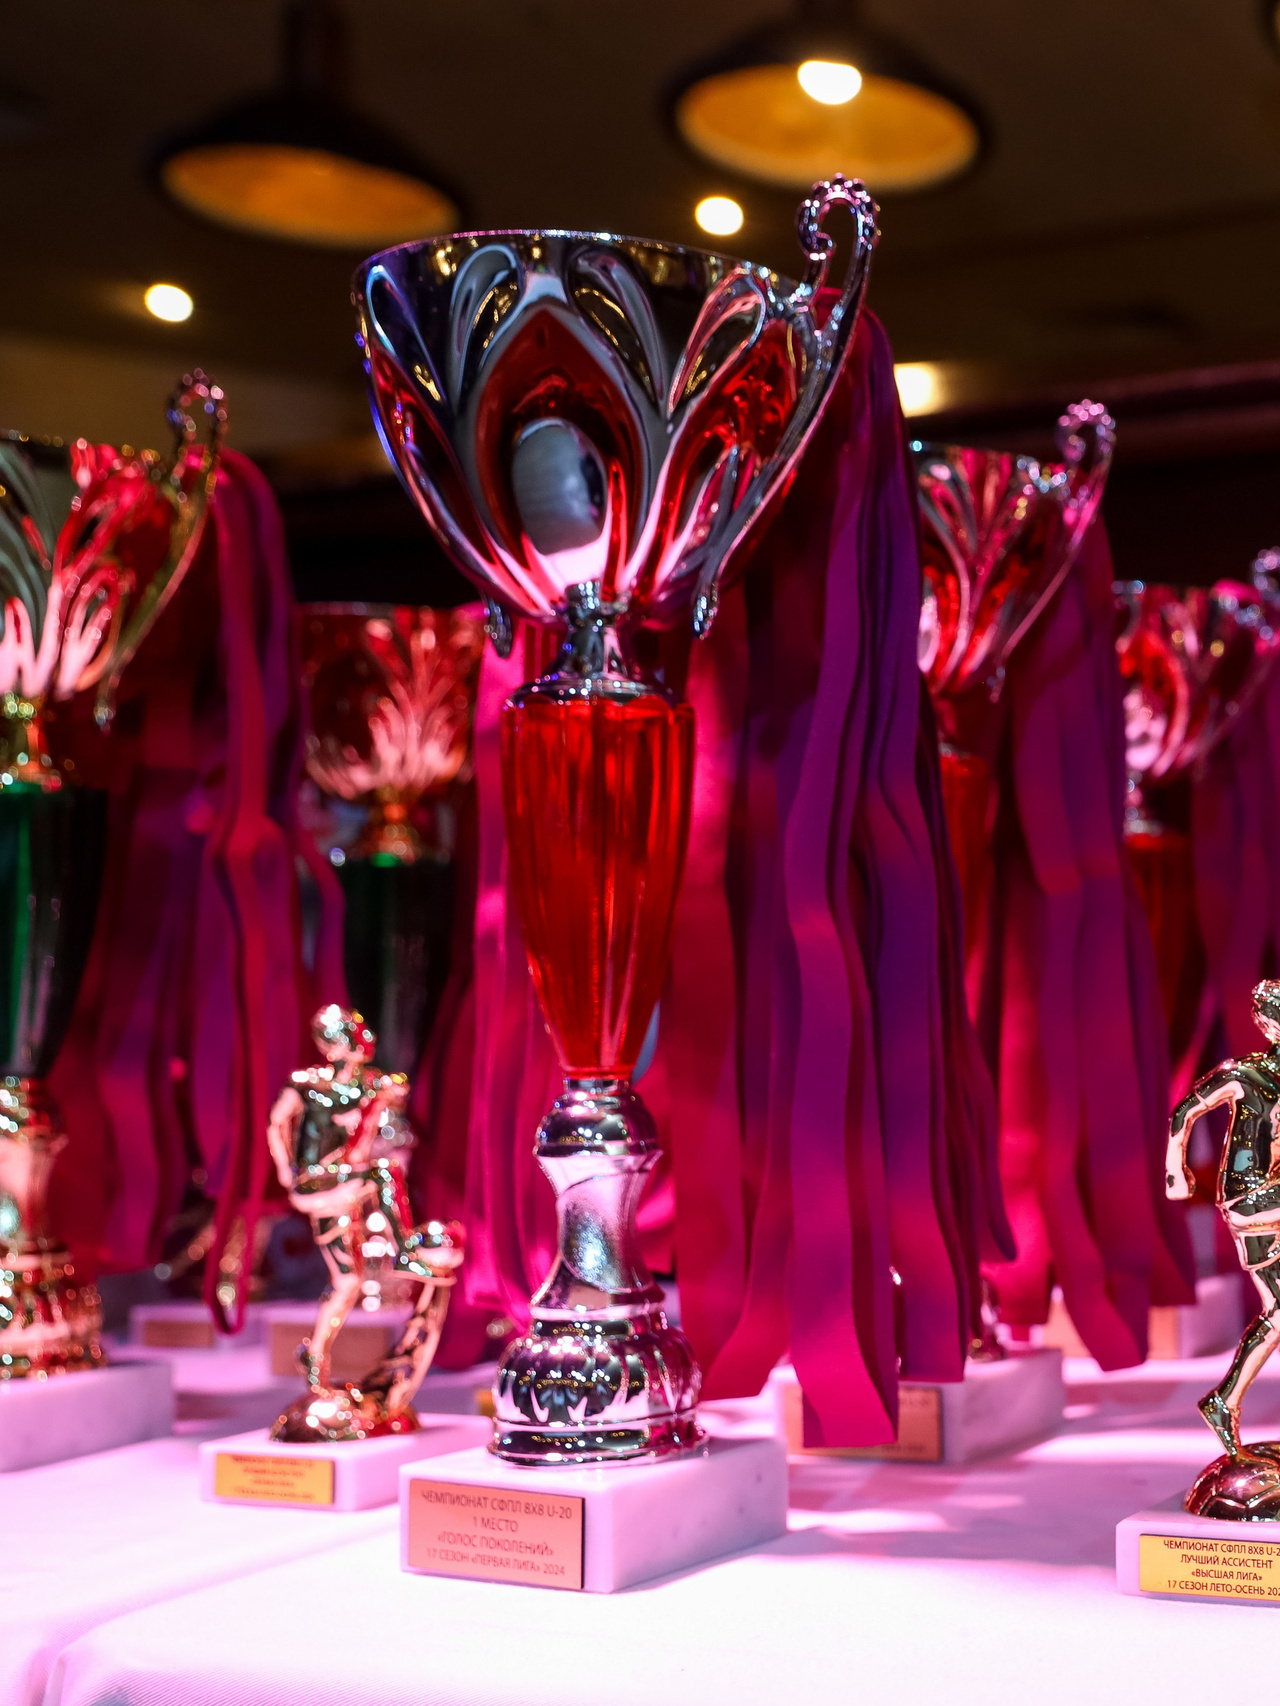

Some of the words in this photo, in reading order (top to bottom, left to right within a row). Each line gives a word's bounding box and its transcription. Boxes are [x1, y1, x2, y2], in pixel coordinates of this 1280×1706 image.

[421, 1489, 488, 1509] ЧЕМПИОНАТ
[490, 1498, 522, 1513] СФПЛ
[524, 1501, 544, 1516] 8X8
[547, 1504, 573, 1520] U-20
[473, 1516, 478, 1528] 1
[480, 1517, 519, 1532] МЕСТО
[437, 1530, 479, 1548] «ГОЛОС
[480, 1536, 554, 1557] ПОКОЛЕНИЙ»
[1163, 1539, 1219, 1552] ЧЕМПИОНАТ
[1220, 1543, 1247, 1554] СФПЛ
[1248, 1545, 1265, 1555] 8X8
[427, 1547, 437, 1558] 17
[439, 1549, 470, 1563] СЕЗОН
[471, 1553, 511, 1568] «ПЕРВАЯ
[512, 1558, 541, 1572] ЛИГА»
[543, 1564, 565, 1576] 2024
[1180, 1553, 1220, 1565] ЛУЧШИЙ
[1221, 1557, 1273, 1569] АССИСТЕНТ
[1191, 1569, 1234, 1580] «ВЫСШАЯ
[1235, 1571, 1263, 1581] ЛИГА»
[1167, 1580, 1177, 1589] 17
[1179, 1580, 1208, 1591] СЕЗОН
[1210, 1583, 1265, 1595] ЛЕТО-ОСЕНЬ
